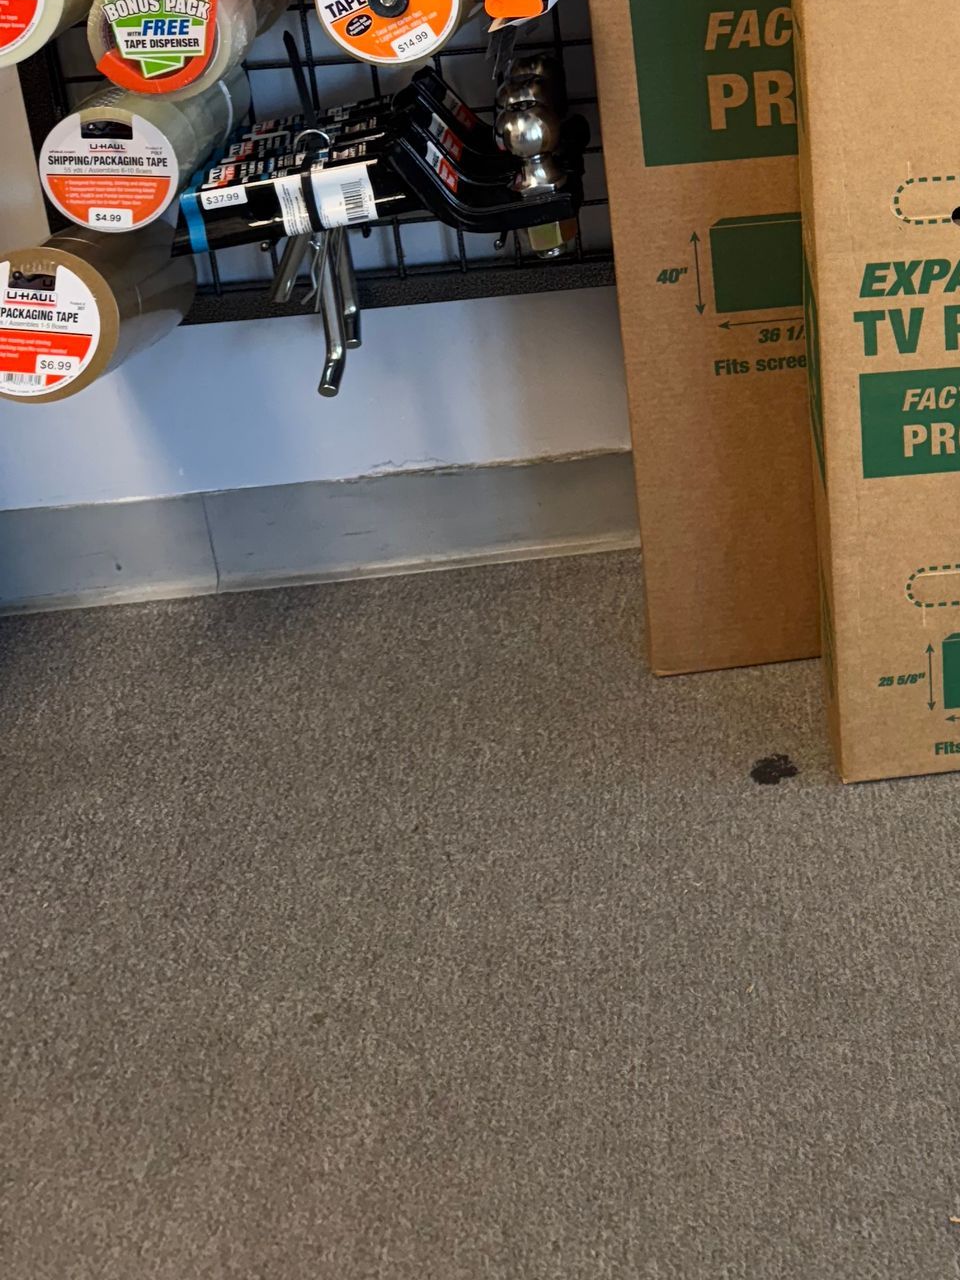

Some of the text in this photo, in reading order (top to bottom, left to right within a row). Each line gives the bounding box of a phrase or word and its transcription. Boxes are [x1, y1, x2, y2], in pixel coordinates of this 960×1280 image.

[142, 19, 190, 37] FREE
[124, 38, 200, 49] TAPE DISPENSER
[397, 30, 429, 53] $14.99
[48, 155, 168, 167] SHIPPING/PACKAGING TAPE
[206, 192, 240, 205] $37.99
[95, 213, 122, 222] $4.99
[656, 266, 689, 285] 40"
[7, 291, 55, 302] U-HAUL
[56, 311, 79, 323] TAPE
[758, 327, 781, 344] 36
[853, 306, 925, 357] TV
[40, 360, 72, 371] $6.99
[714, 359, 750, 377] Fits
